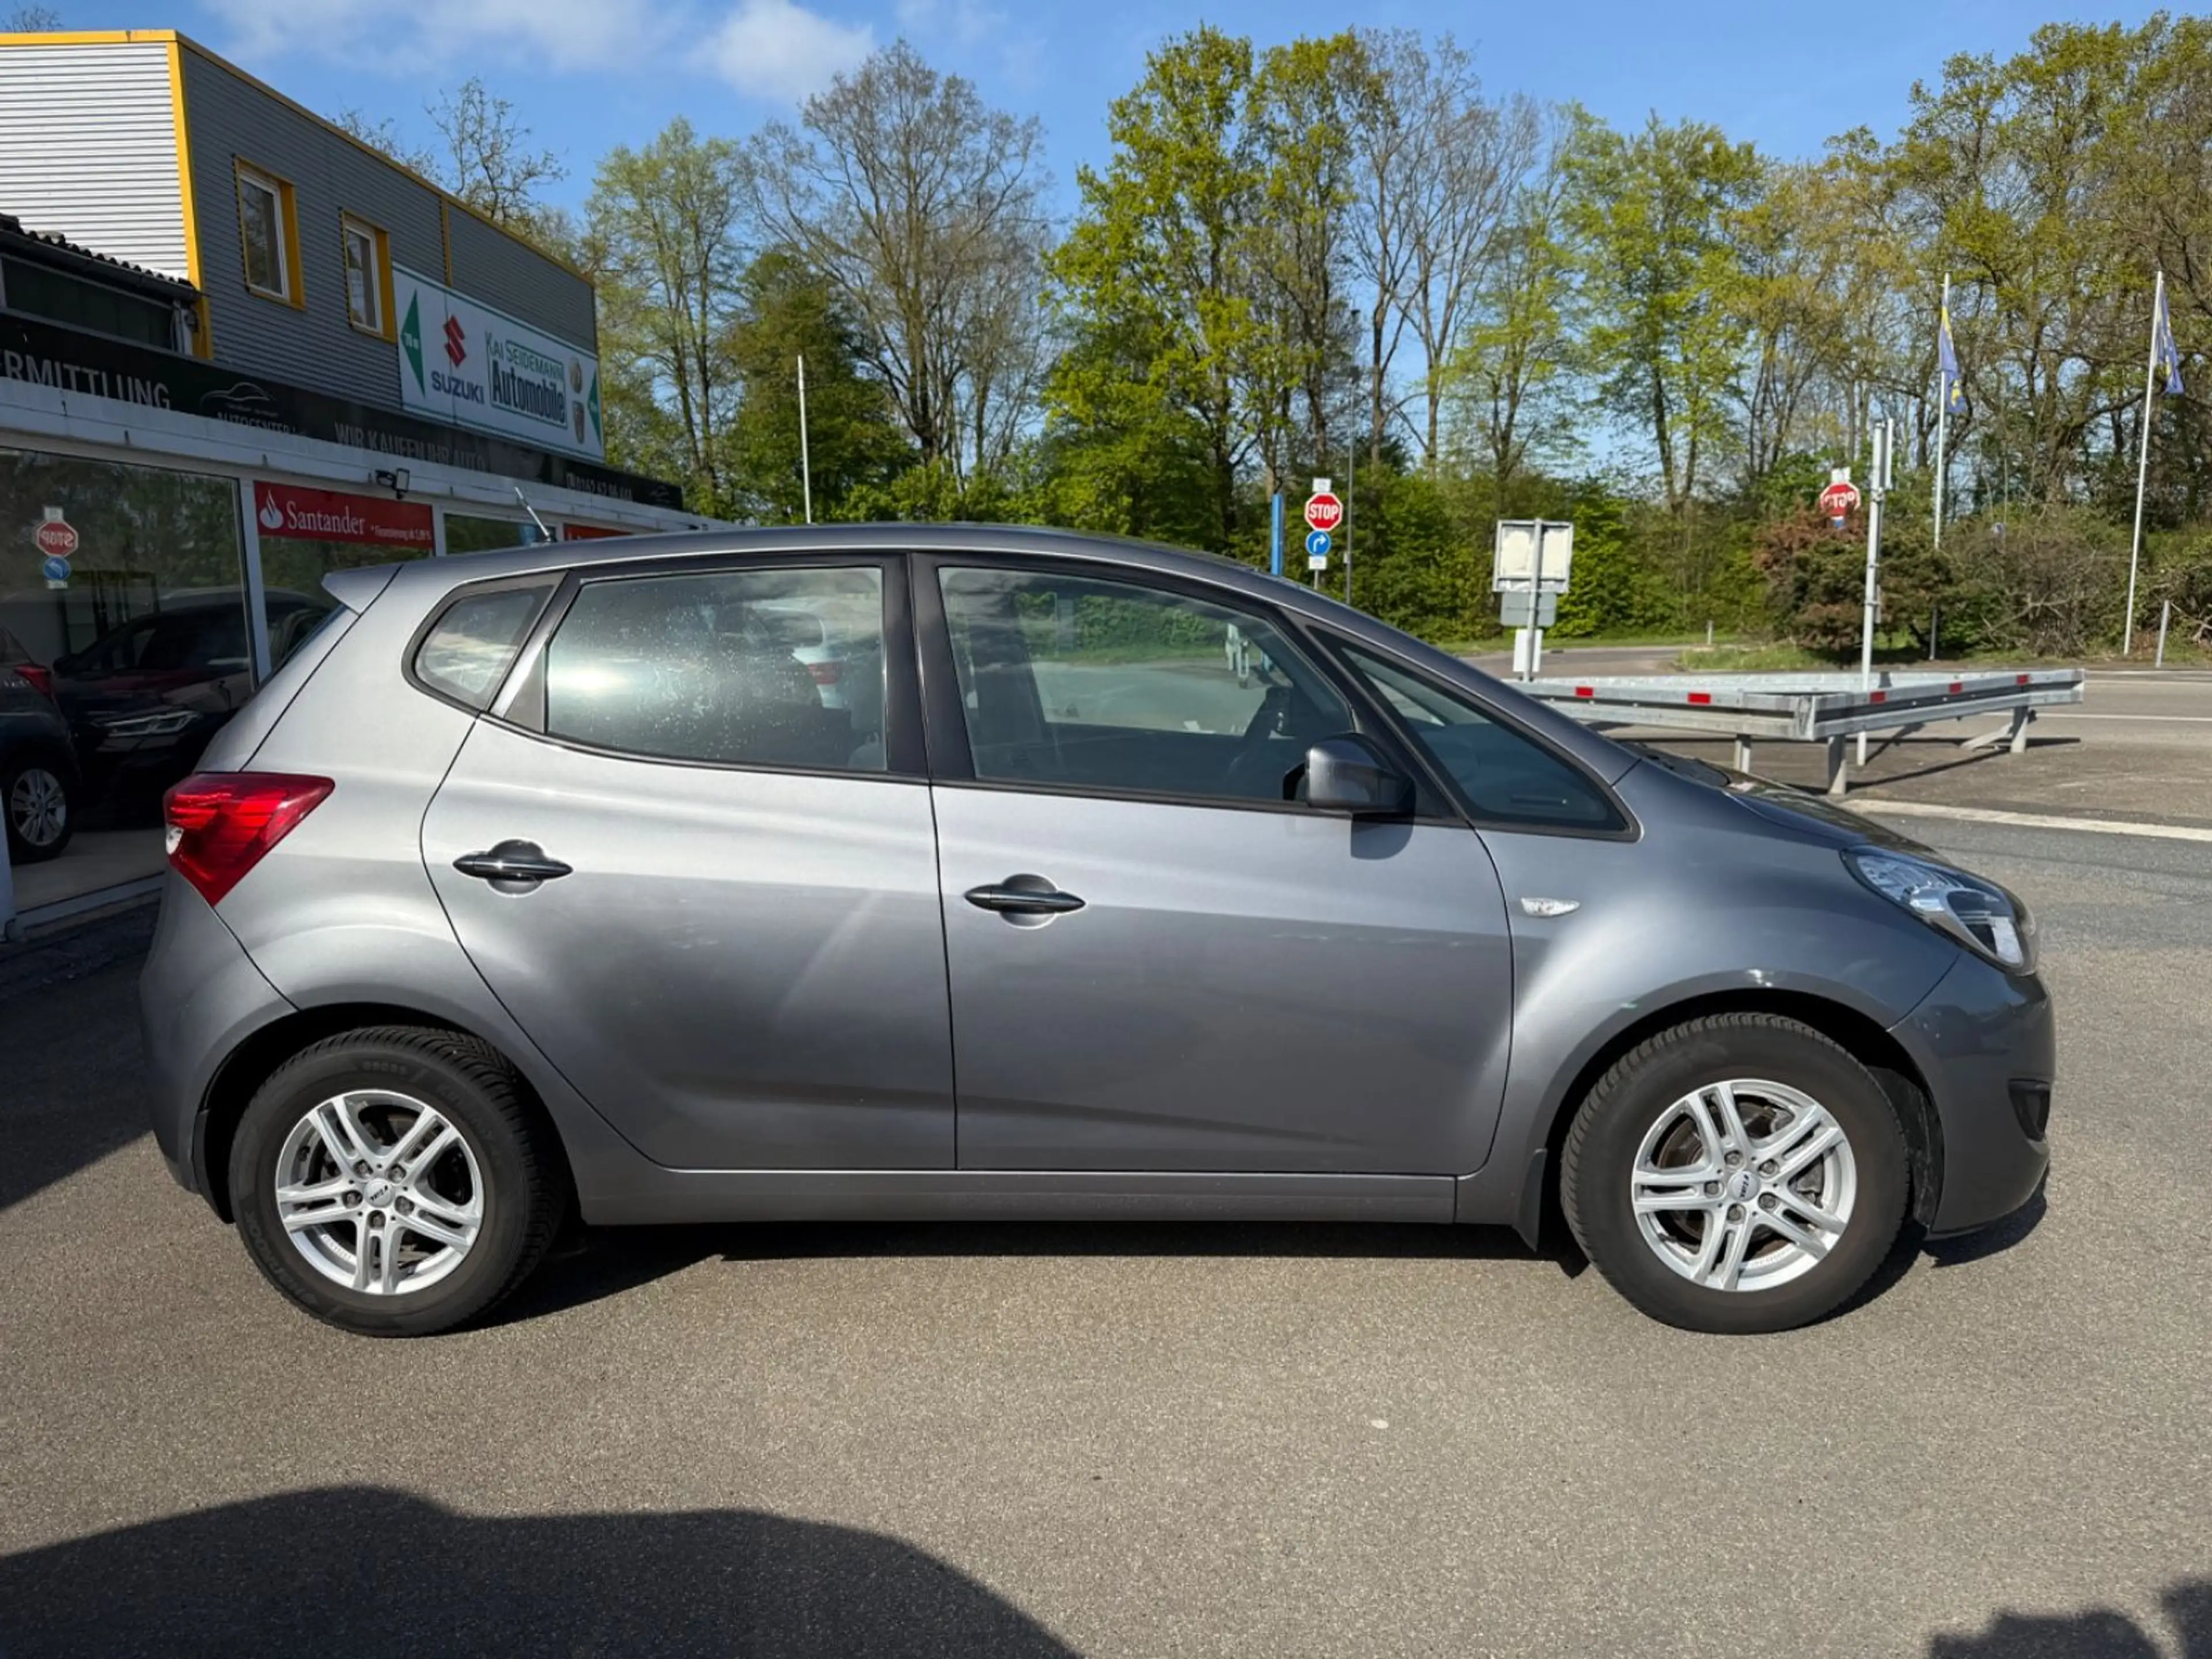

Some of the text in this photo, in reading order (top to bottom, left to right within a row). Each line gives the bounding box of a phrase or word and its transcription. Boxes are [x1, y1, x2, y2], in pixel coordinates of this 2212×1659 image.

[485, 331, 503, 360] KAI
[431, 370, 484, 404] SUZUKI
[493, 360, 565, 423] Automobile
[286, 500, 366, 535] Santander
[1309, 503, 1339, 521] STOP
